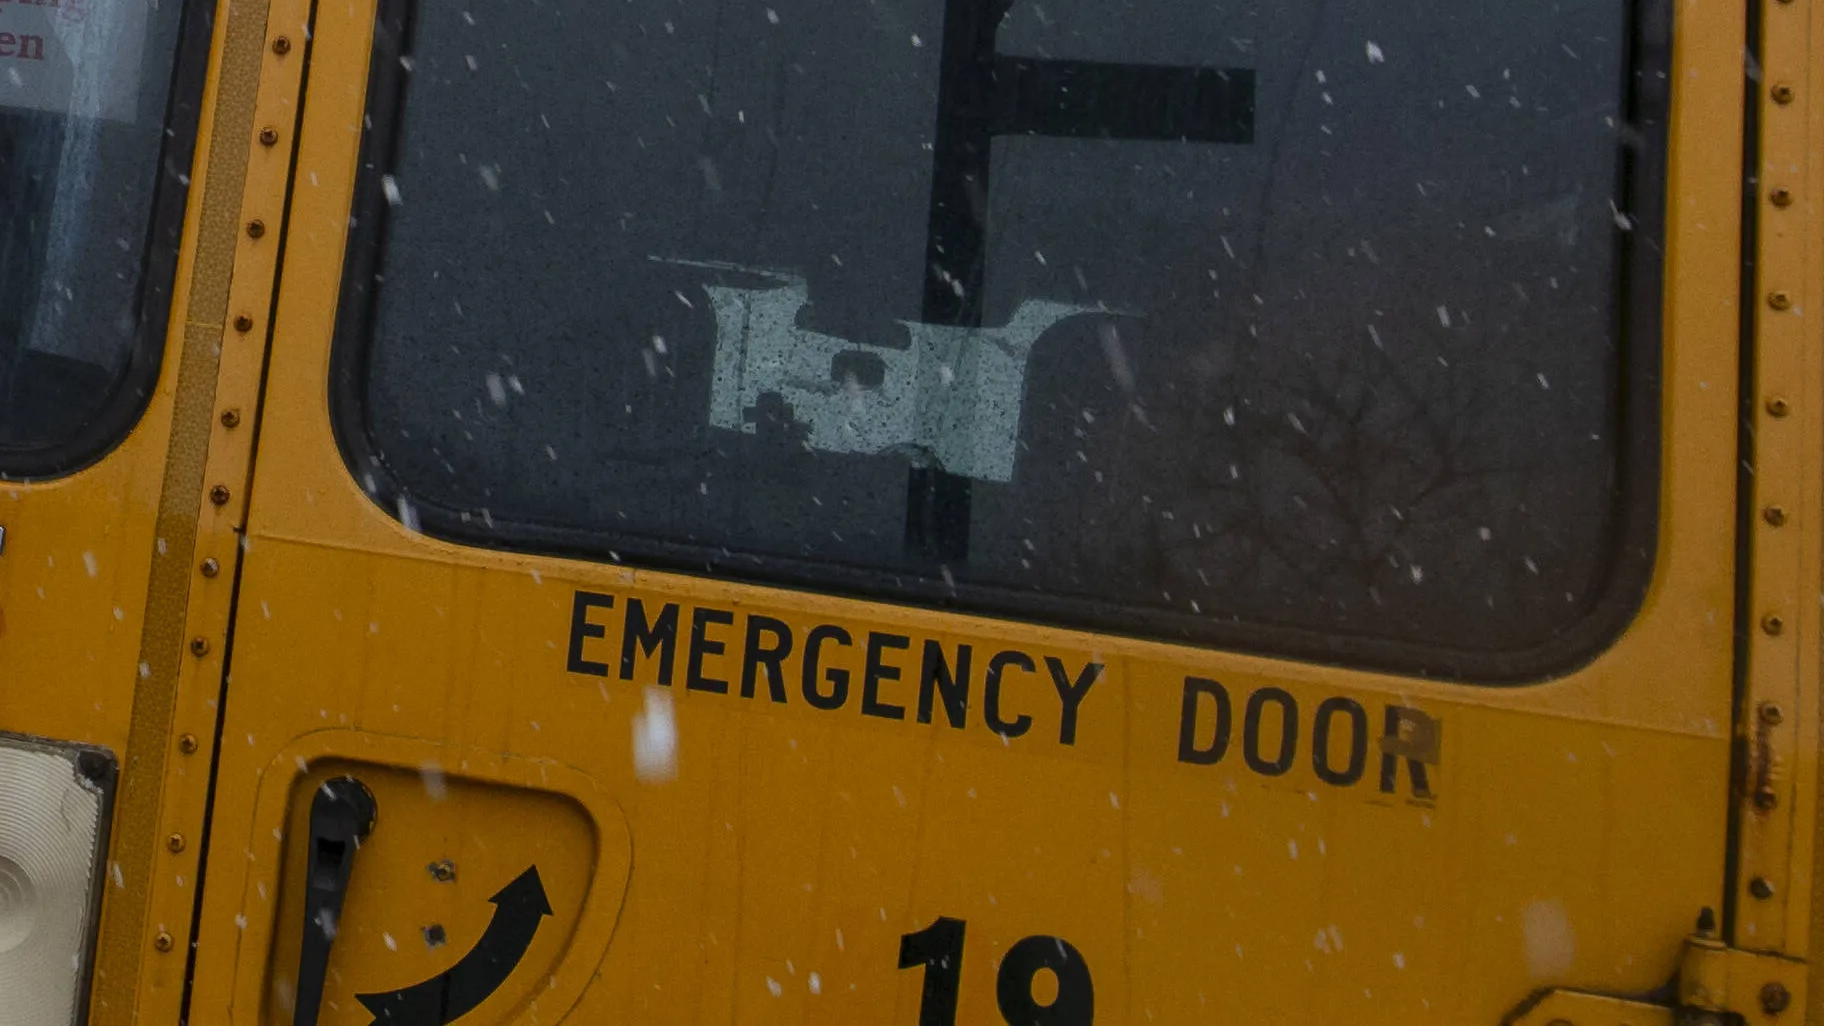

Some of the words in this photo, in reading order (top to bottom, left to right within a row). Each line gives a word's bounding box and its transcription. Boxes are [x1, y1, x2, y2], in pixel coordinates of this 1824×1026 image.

[566, 589, 1105, 746] EMERGENCY
[1177, 674, 1434, 799] DOOR
[898, 915, 1095, 1026] 19
